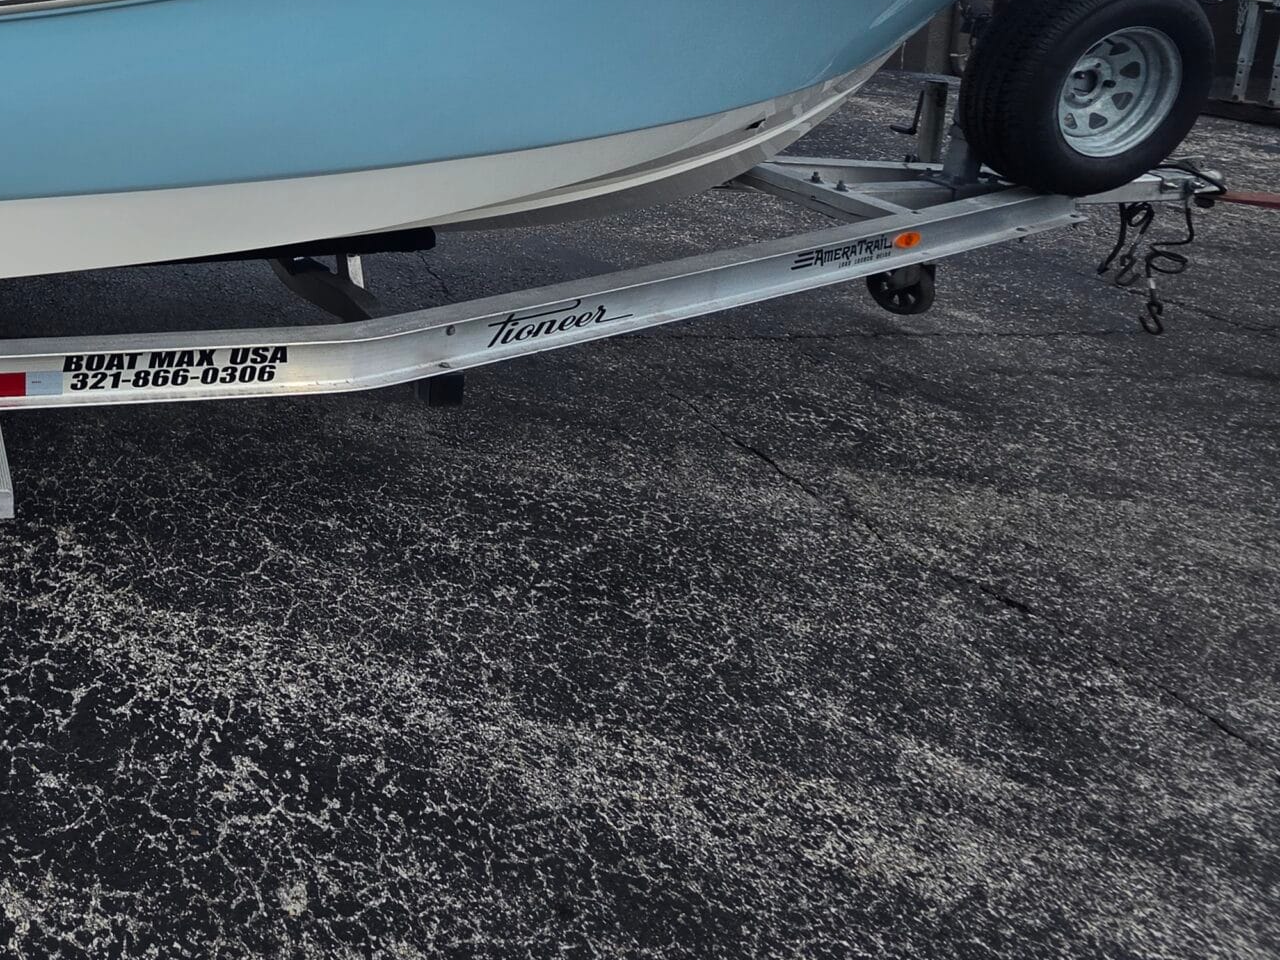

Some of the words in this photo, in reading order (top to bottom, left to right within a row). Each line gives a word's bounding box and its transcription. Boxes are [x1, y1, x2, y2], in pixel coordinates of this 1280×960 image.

[487, 299, 633, 348] Pioneer
[62, 353, 143, 372] BOAT
[148, 349, 217, 368] MAX
[229, 346, 288, 365] USA
[70, 365, 277, 390] 321-866-0306
